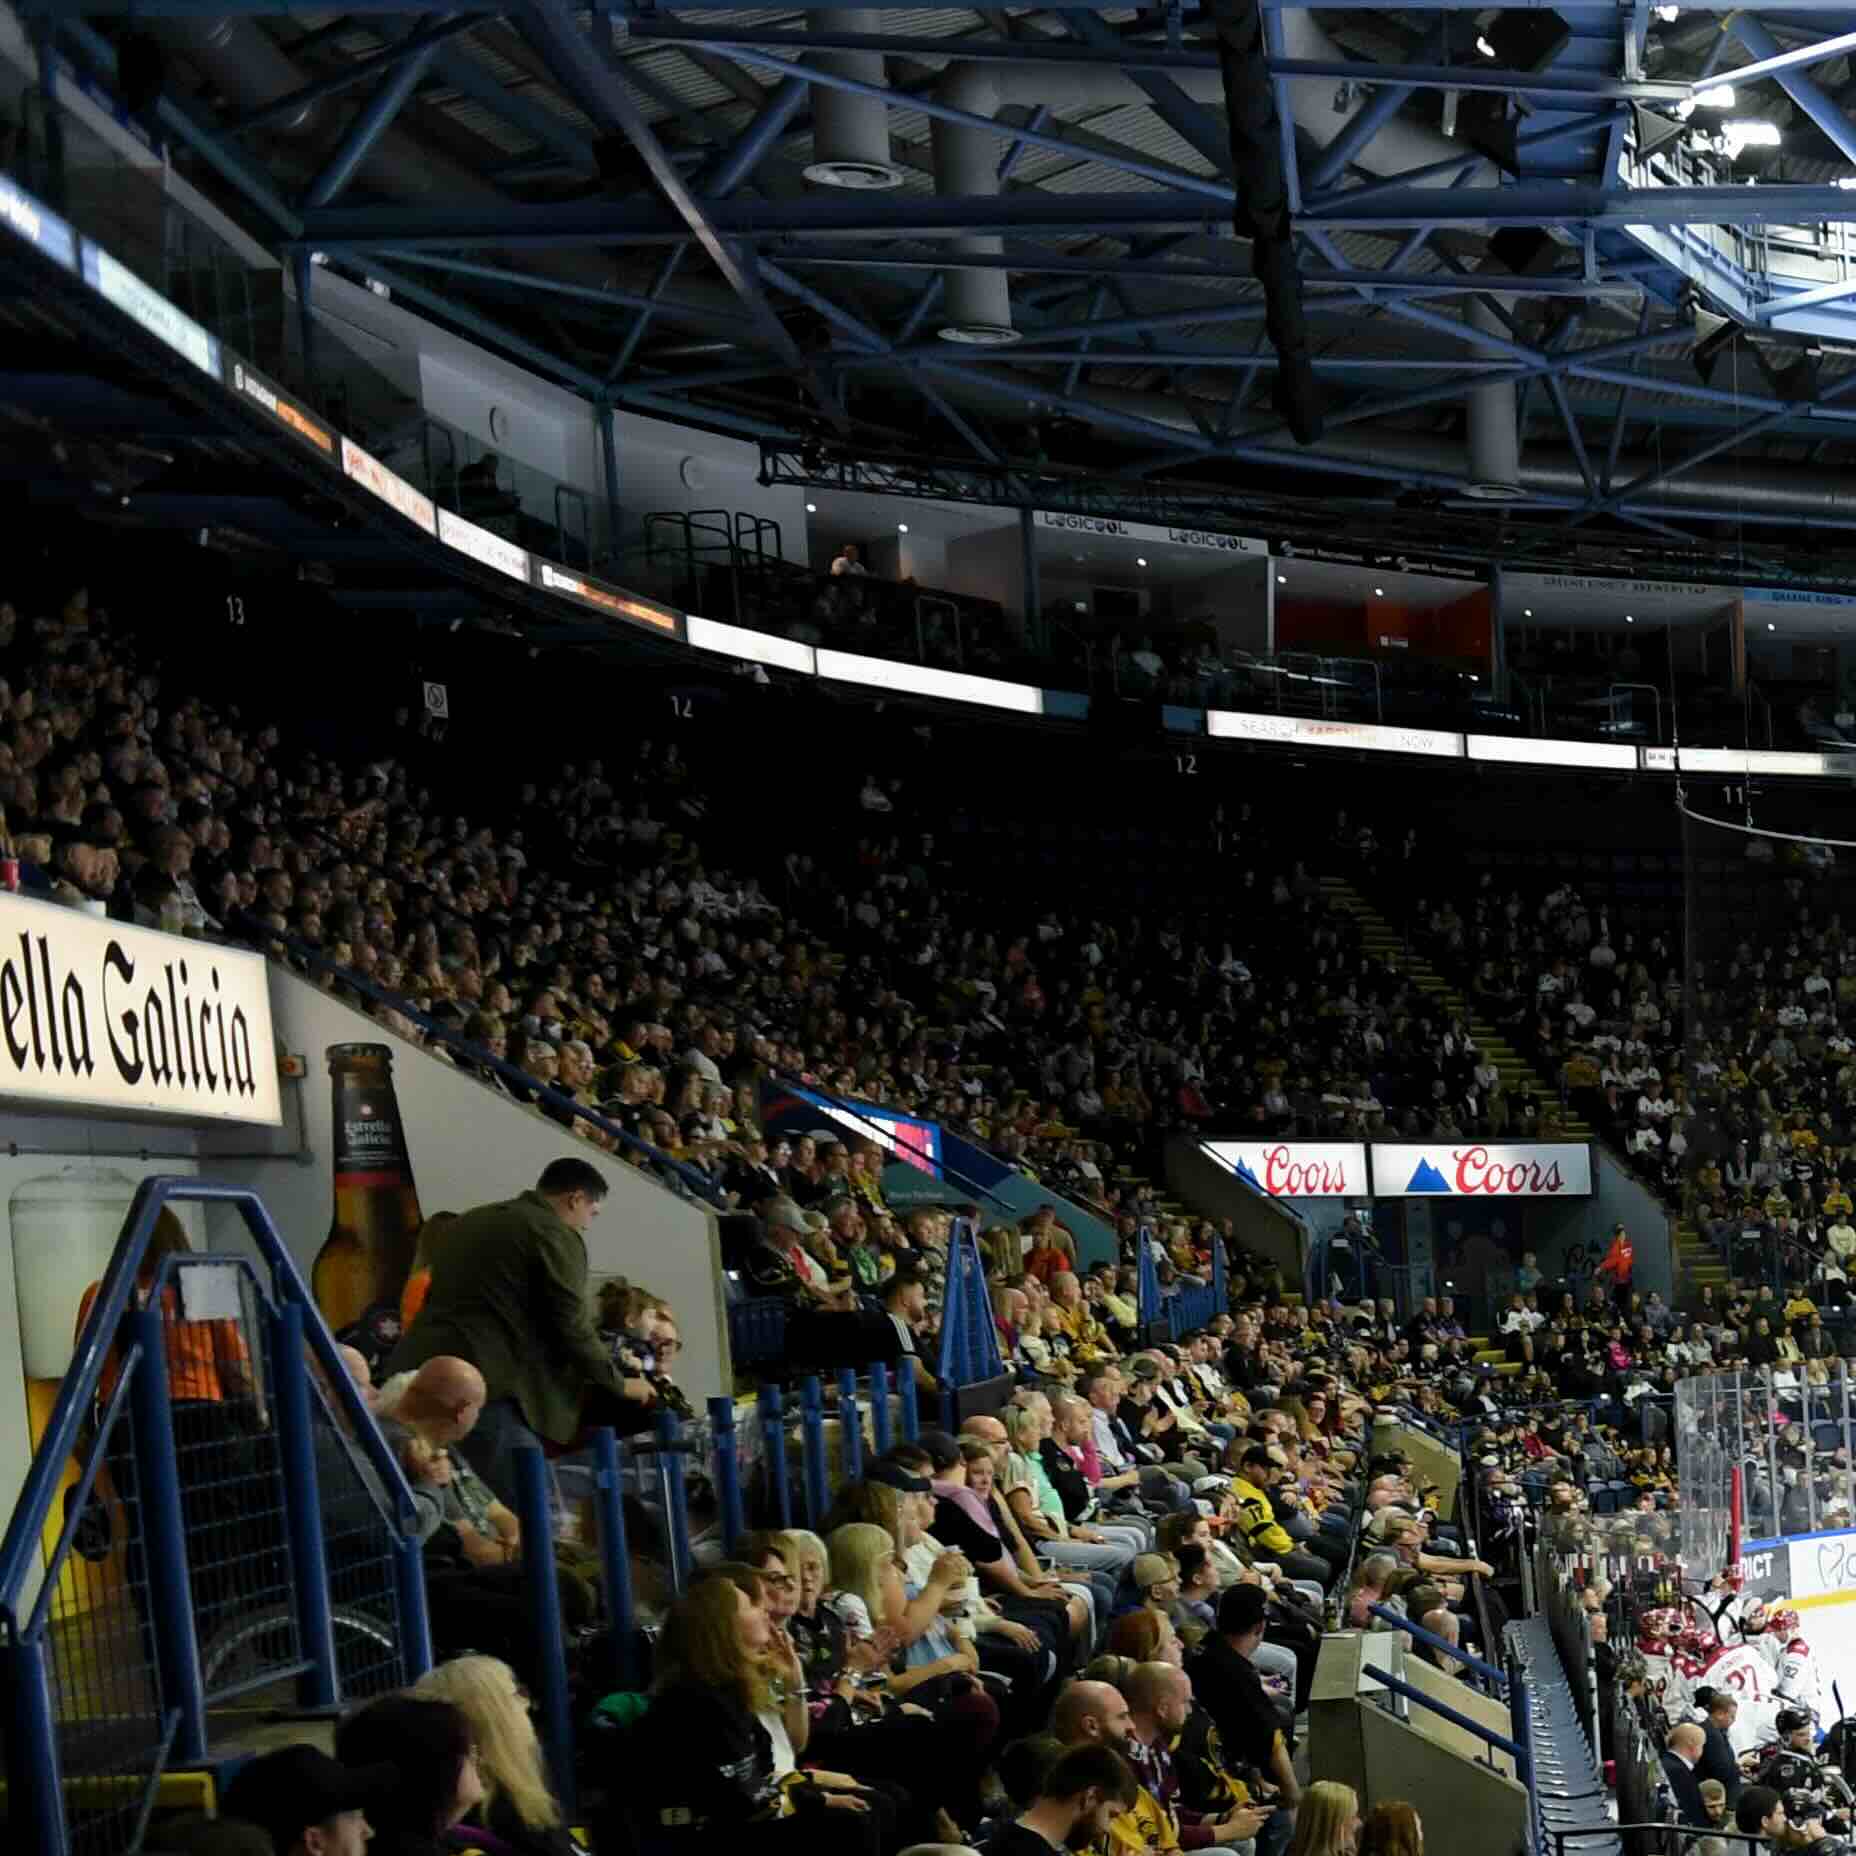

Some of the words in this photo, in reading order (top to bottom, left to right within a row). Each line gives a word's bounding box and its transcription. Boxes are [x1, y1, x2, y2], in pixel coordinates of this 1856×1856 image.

[226, 595, 245, 625] 13
[1176, 754, 1199, 775] 12
[1722, 786, 1744, 805] 11
[103, 940, 257, 1100] Galicia
[1263, 1145, 1346, 1196] Coors
[1453, 1147, 1565, 1195] Coors
